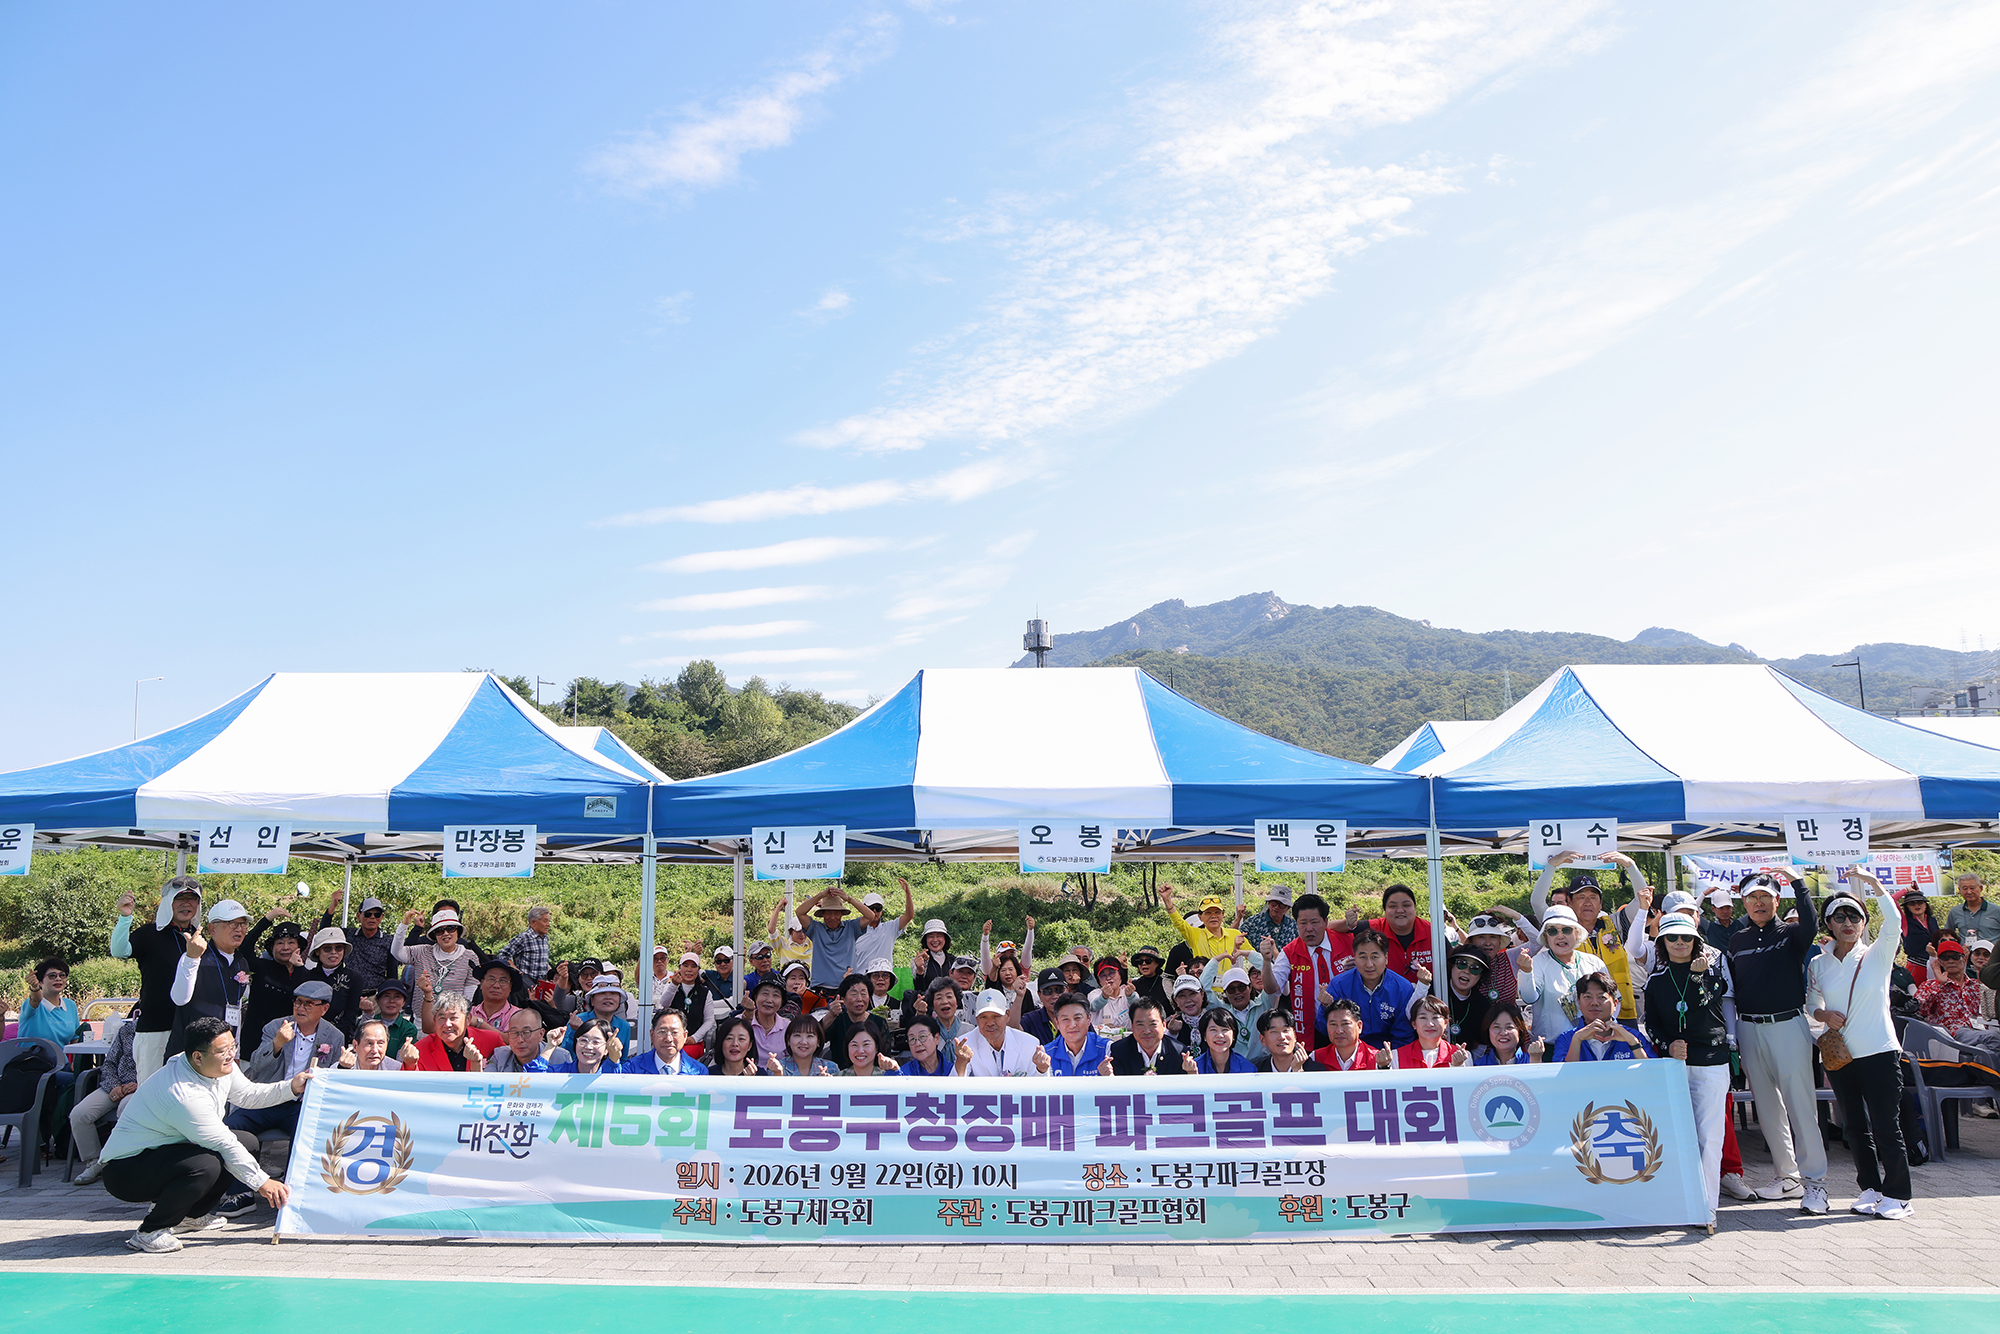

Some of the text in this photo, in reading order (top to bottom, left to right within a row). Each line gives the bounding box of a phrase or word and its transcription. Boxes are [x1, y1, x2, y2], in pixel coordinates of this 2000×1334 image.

[455, 829, 525, 853] 만장봉
[1815, 849, 1860, 857] 도봉구파크골프협회
[220, 857, 268, 865] 도봉구파크골프협회
[1294, 972, 1305, 1034] 서울아레나
[462, 1084, 505, 1121] 도봉
[1470, 1078, 1536, 1109] Dobong Sports Council
[547, 1085, 1459, 1152] 제5회 도봉구청장배 파크골프 대회
[341, 1123, 397, 1185] 경
[457, 1121, 539, 1159] 대전환
[1592, 1111, 1647, 1172] 축
[675, 1162, 721, 1190] 일시
[743, 1162, 821, 1189] 2026년
[830, 1162, 867, 1190] 9월
[875, 1162, 963, 1190] 22일(화)
[972, 1162, 1018, 1190] 10시
[1082, 1162, 1128, 1190] 장소
[1150, 1160, 1327, 1190] 도봉구파크골프장
[672, 1197, 718, 1225] 주최
[739, 1198, 873, 1226] 도봉구체육회
[937, 1198, 983, 1227] 주관
[1005, 1197, 1206, 1226] 도봉구파크골프협회
[1278, 1193, 1323, 1223] 후원
[1346, 1192, 1411, 1220] 도봉구
